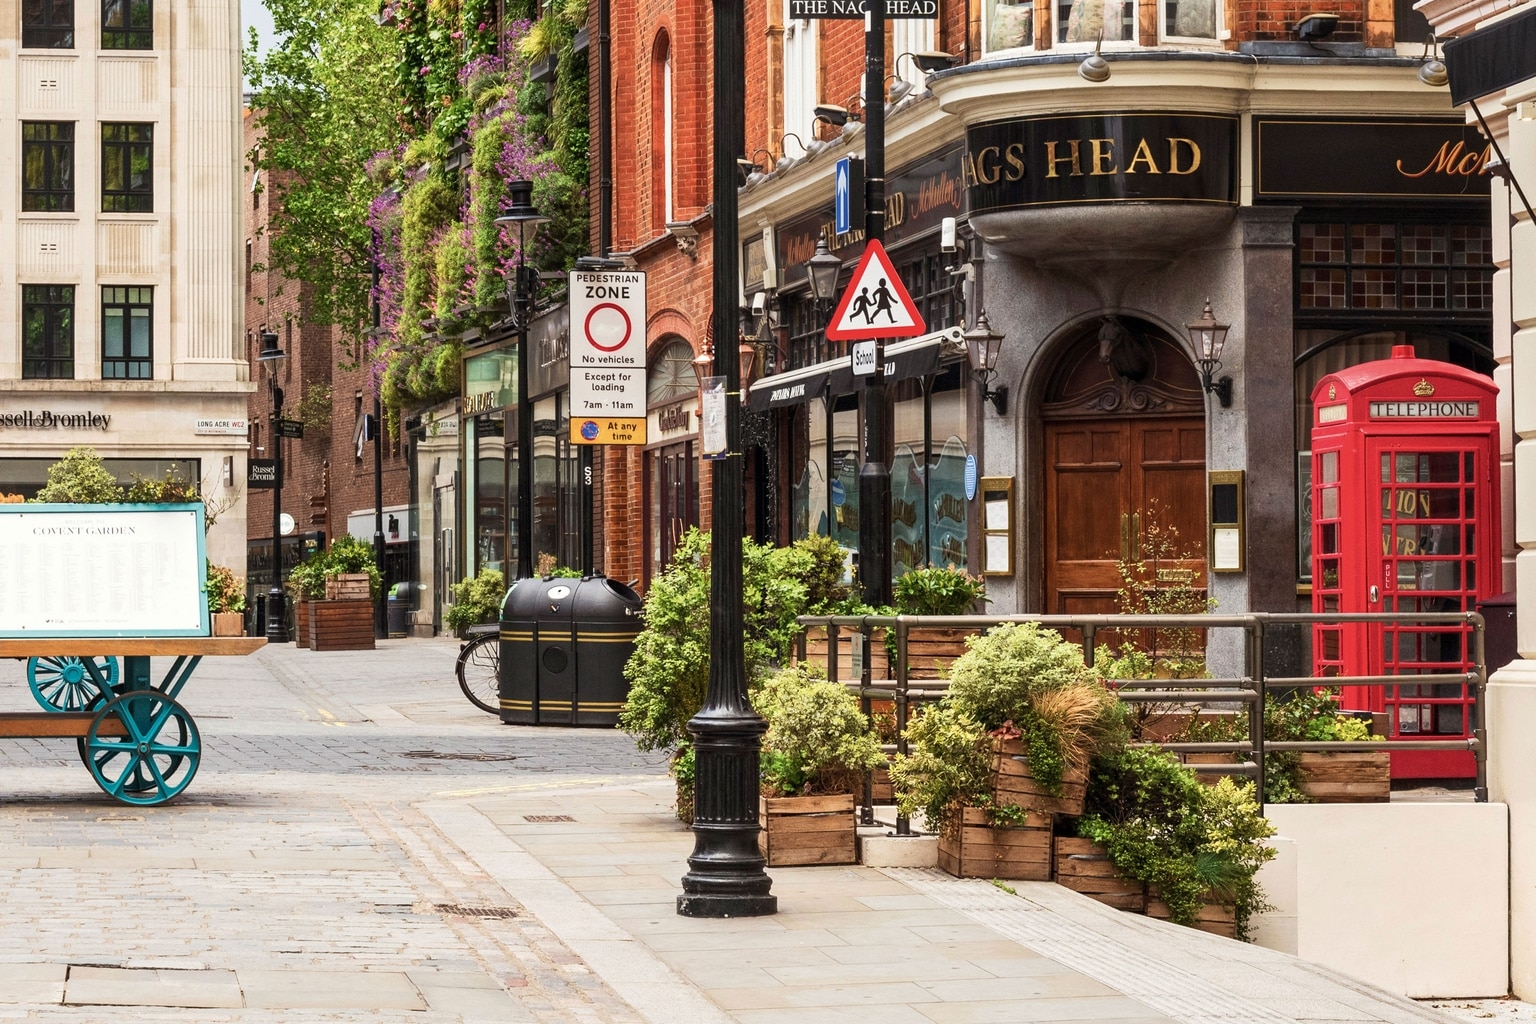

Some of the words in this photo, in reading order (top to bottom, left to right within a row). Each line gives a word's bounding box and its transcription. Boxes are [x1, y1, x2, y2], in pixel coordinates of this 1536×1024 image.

[792, 0, 828, 15] THE
[885, 0, 936, 15] HEAD
[1043, 137, 1202, 179] HEAD
[576, 274, 639, 283] PEDESTRIAN
[585, 285, 630, 299] ZONE
[582, 355, 595, 364] No
[598, 355, 635, 364] vehicles
[855, 349, 874, 366] School
[584, 372, 616, 382] Except
[618, 372, 632, 381] for
[591, 382, 625, 392] loading
[583, 400, 603, 409] 7am
[611, 400, 634, 409] 11am
[1375, 403, 1475, 417] TELEPHONE
[607, 422, 618, 430] At
[620, 423, 637, 432] any
[613, 433, 633, 441] time
[32, 527, 82, 535] COVENT
[85, 527, 136, 535] GARDEN
